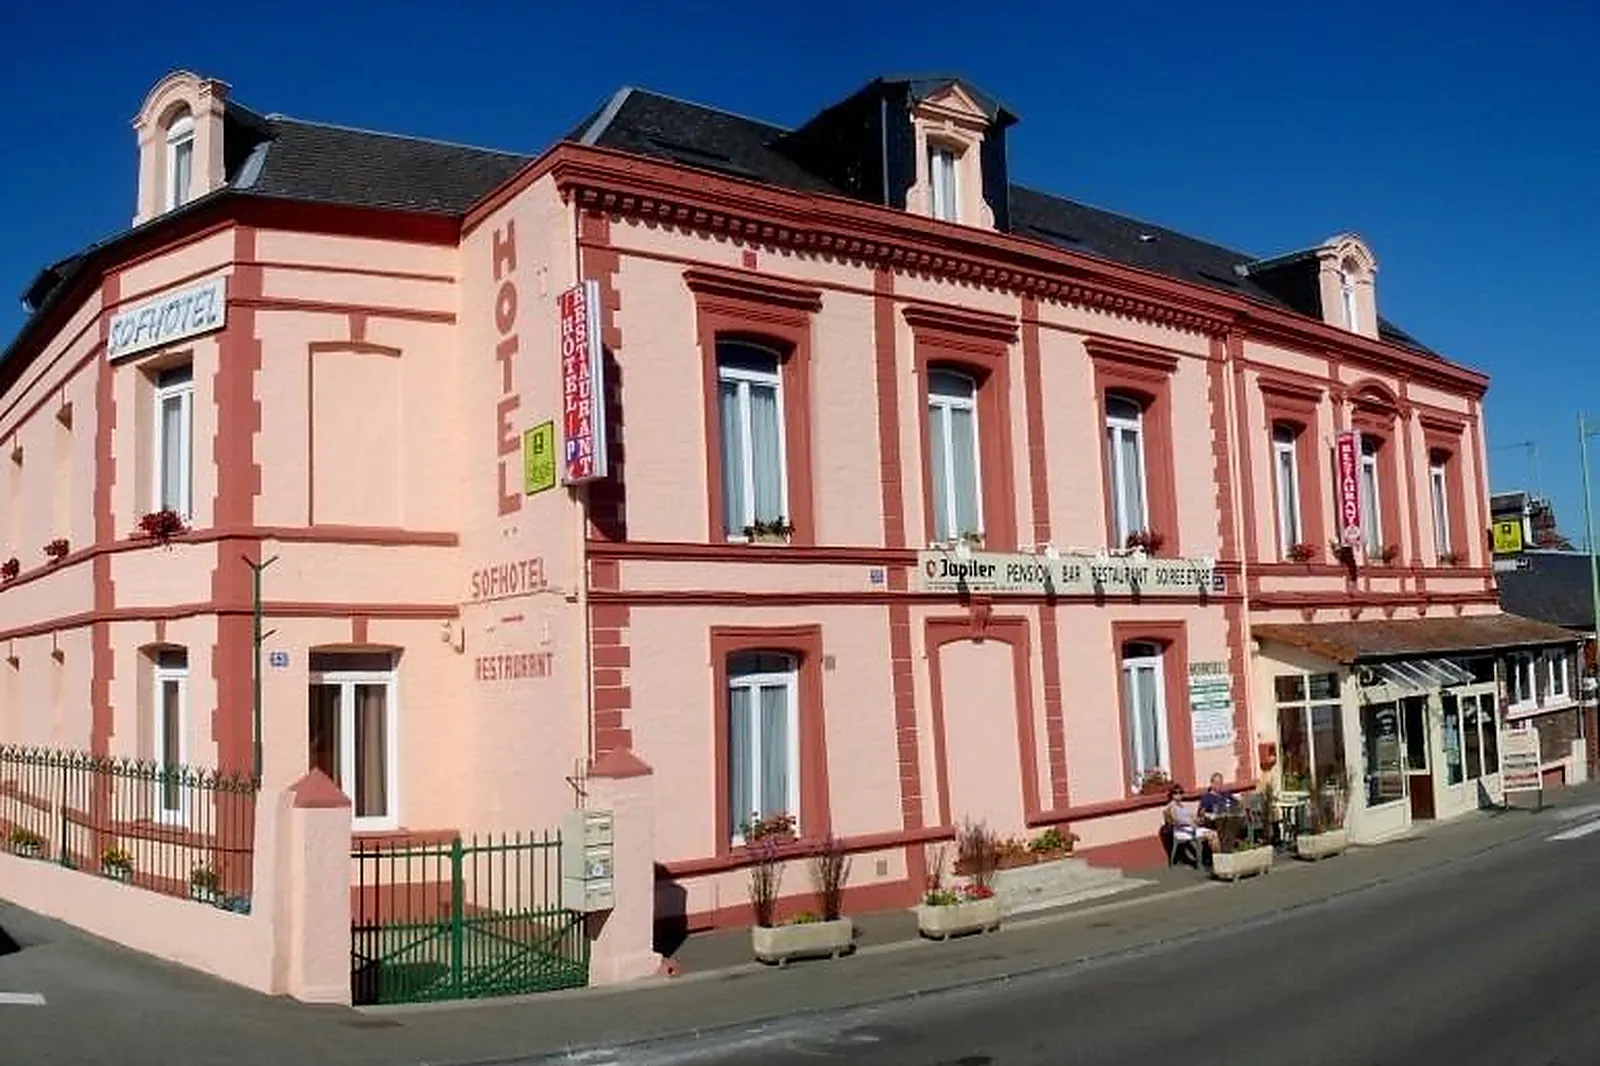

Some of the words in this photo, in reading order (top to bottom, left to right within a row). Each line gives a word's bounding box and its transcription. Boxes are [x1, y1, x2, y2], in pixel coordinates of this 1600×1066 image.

[109, 286, 217, 356] SOFHOTEL
[492, 219, 521, 517] HOTEL
[573, 285, 593, 477] RESTAURANT
[472, 558, 548, 598] SOFHOTEL
[940, 559, 996, 580] Jupiler
[1006, 563, 1051, 584] PENSION
[1062, 564, 1080, 583] BAR
[1091, 566, 1149, 585] RESTAURANT
[475, 652, 553, 681] RESTAURANT
